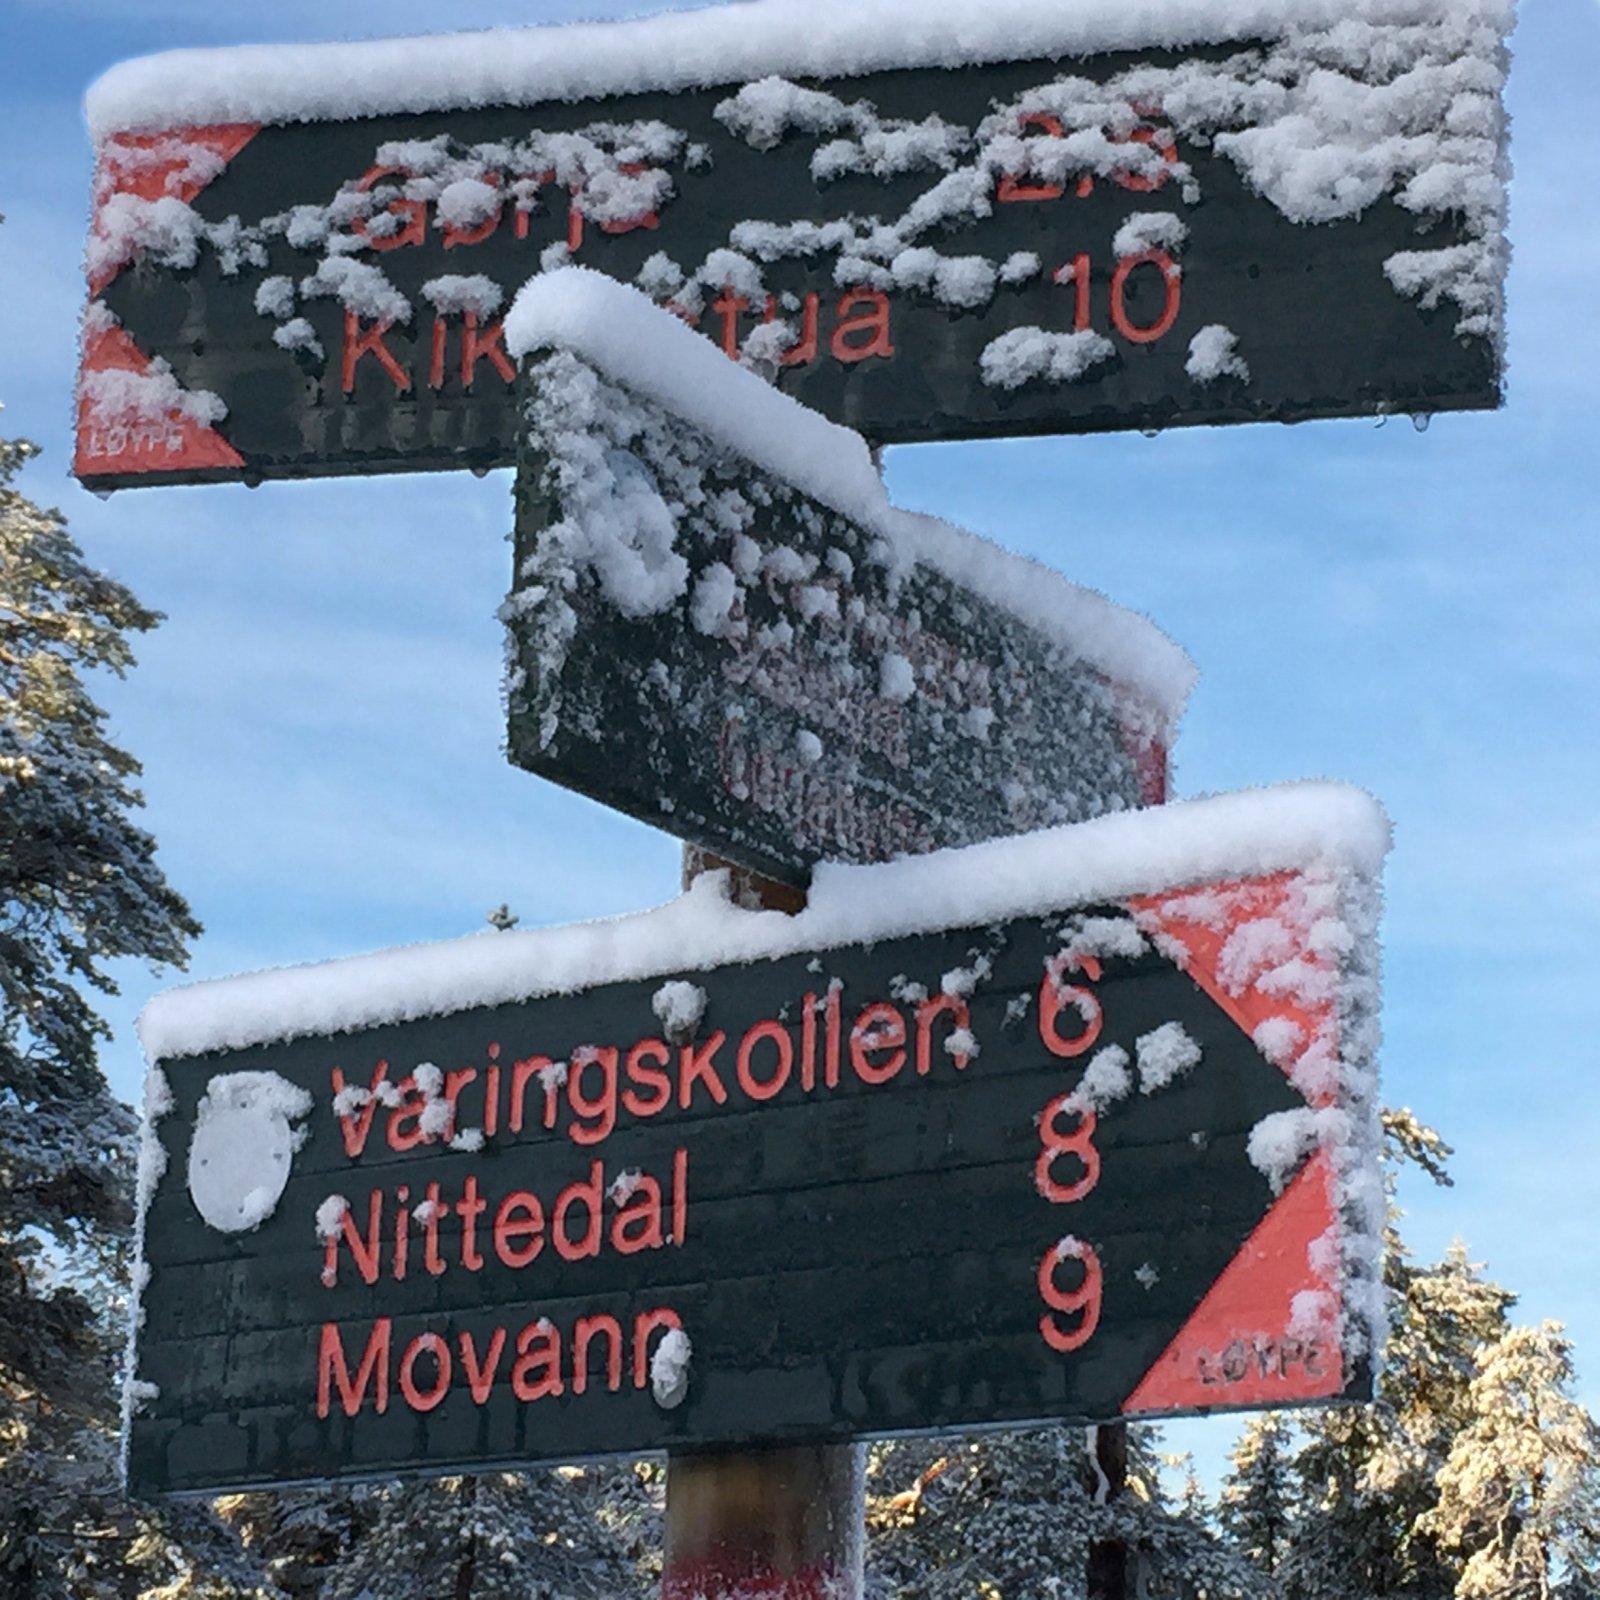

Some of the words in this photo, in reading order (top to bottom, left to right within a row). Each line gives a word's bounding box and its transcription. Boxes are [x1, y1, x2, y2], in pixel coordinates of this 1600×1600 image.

[341, 275, 895, 393] Kiktua
[1053, 246, 1182, 344] 10
[332, 986, 972, 1157] Varingskollen
[1039, 953, 1103, 1057] 6
[321, 1148, 687, 1288] Nittedal
[1035, 1094, 1102, 1203] 8
[317, 1307, 686, 1419] Movann
[1038, 1237, 1103, 1352] 9
